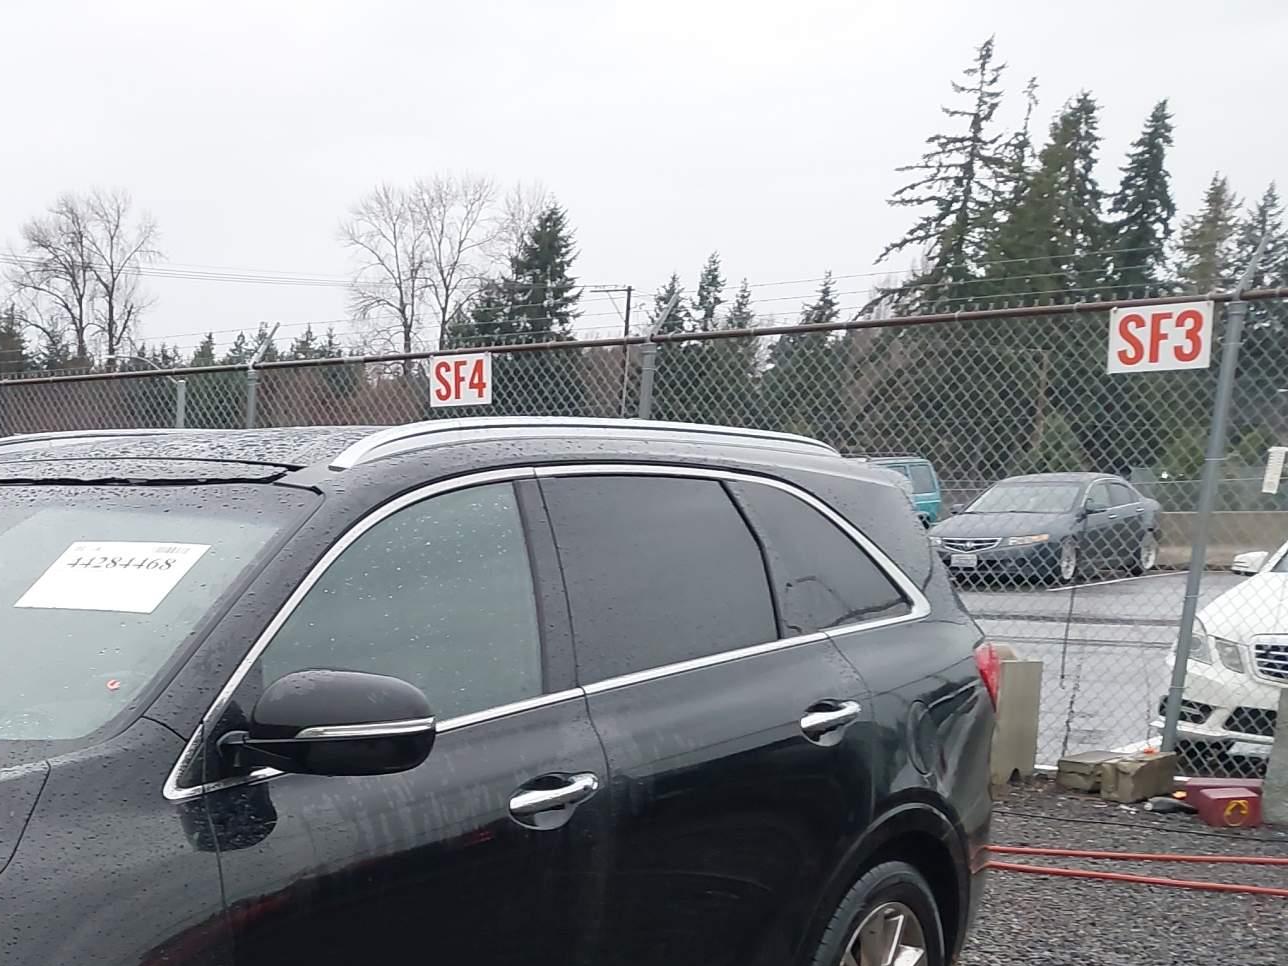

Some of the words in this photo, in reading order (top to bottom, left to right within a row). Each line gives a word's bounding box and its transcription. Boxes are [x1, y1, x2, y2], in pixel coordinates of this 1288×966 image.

[1117, 309, 1203, 366] SF3
[435, 358, 487, 401] SF4
[66, 556, 177, 571] 44284468
